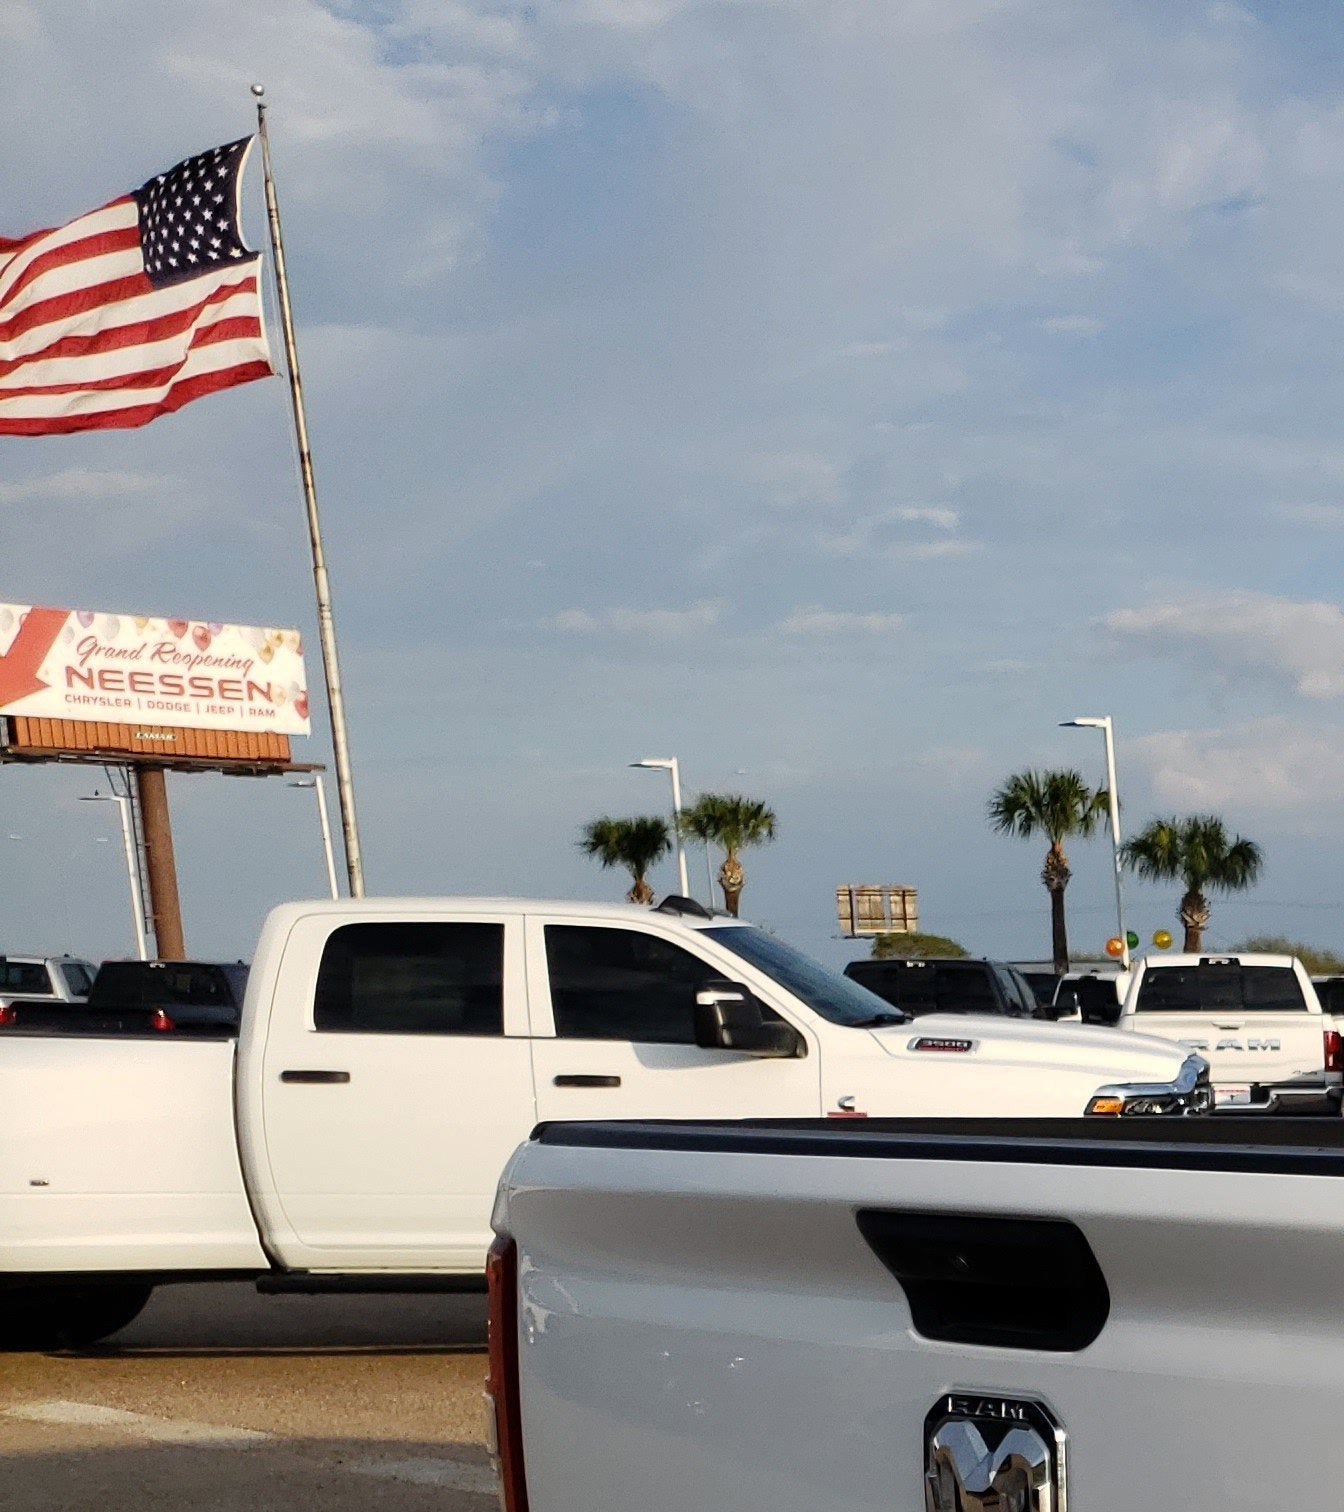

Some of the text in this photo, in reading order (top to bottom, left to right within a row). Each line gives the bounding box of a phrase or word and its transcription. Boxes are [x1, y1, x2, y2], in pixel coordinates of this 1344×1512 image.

[77, 635, 254, 678] Grand Reopening
[65, 665, 273, 702] NEESSEN
[64, 694, 277, 719] CHRYSLER DODGE JEEP RAM
[1177, 1039, 1281, 1051] RAM
[947, 1396, 1025, 1420] RAM
